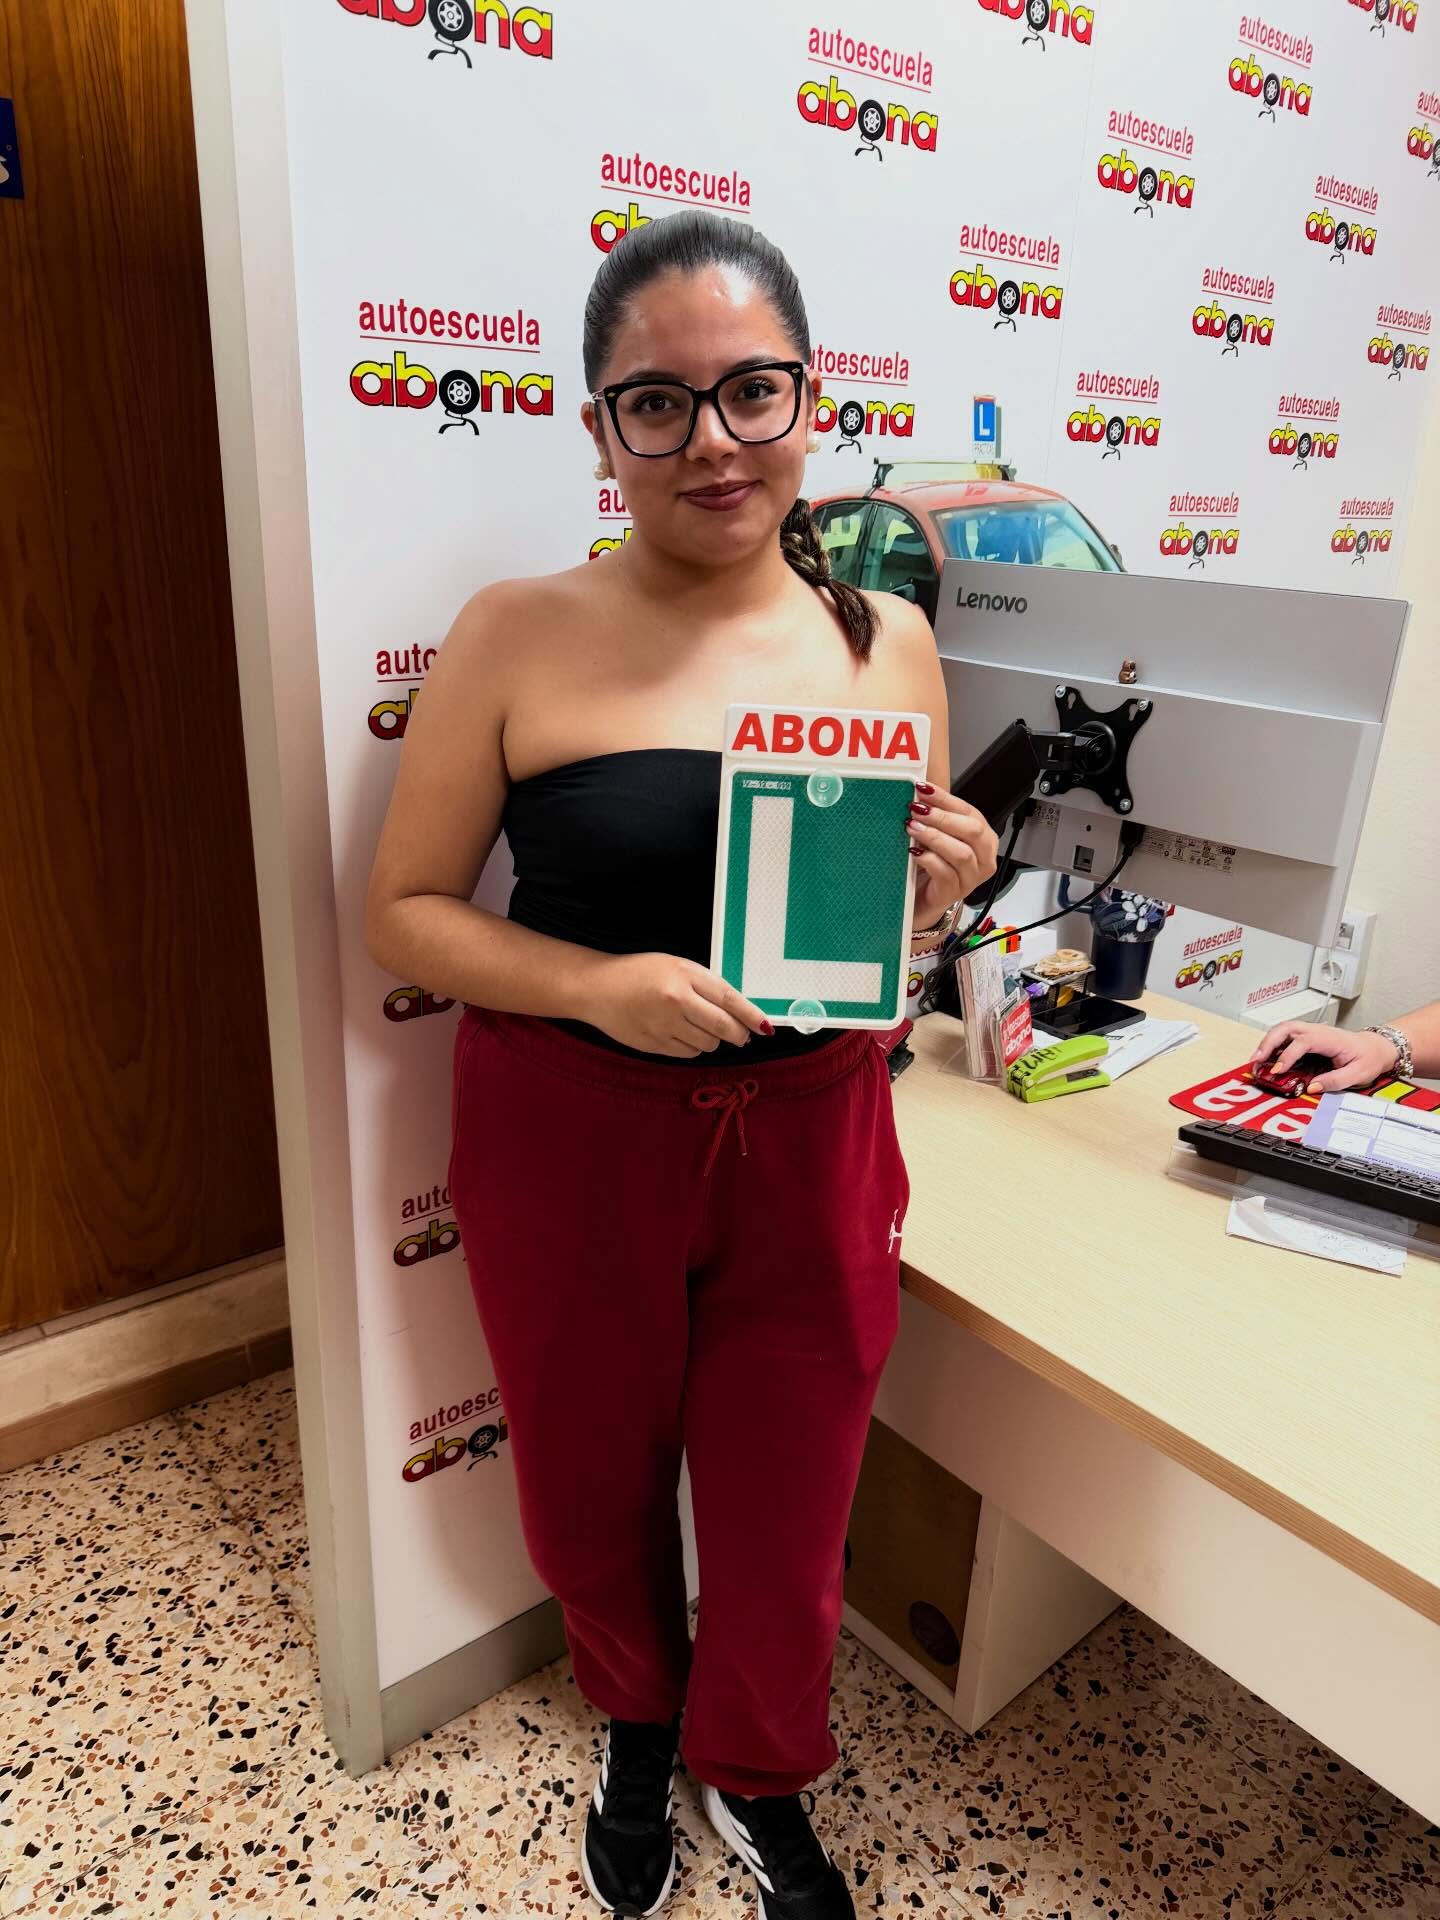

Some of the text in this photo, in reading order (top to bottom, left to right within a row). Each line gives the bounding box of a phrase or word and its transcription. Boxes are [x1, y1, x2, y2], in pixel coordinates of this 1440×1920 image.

[977, 0, 1095, 46] ona
[1240, 16, 1313, 63] autoescuela
[807, 27, 933, 88] autoescuela
[1228, 53, 1313, 117] abona
[797, 74, 939, 153] abona
[1107, 110, 1194, 155] autoescuela
[601, 152, 751, 207] autoescuela
[1097, 148, 1195, 209] abona
[1315, 173, 1379, 211] autoescuela
[960, 223, 1061, 265] autoescuela
[1305, 207, 1377, 257] abona
[949, 263, 1063, 320] abona
[1202, 266, 1275, 300] autoescuela
[359, 298, 541, 346] autoescuela
[1192, 300, 1275, 347] abona
[1377, 303, 1432, 332] autoescuela
[809, 344, 909, 380] toescuela
[1368, 332, 1430, 372] abona
[349, 350, 554, 417] abona
[1077, 369, 1159, 400] autoescuela
[979, 403, 991, 437] L
[1066, 404, 1162, 447] abona
[1278, 392, 1340, 419] autoescuela
[1268, 422, 1340, 460] abona
[1169, 491, 1239, 514] autoescuela
[1340, 496, 1394, 518] autoescuela
[1160, 521, 1241, 556] abona
[1331, 522, 1393, 553] abona
[956, 586, 1028, 614] Lenovo
[731, 713, 921, 761] ABONA
[741, 796, 884, 1004] L
[1184, 925, 1243, 957] autoescuela
[1175, 949, 1244, 988] abona
[1247, 974, 1300, 1005] autoescuela
[409, 1386, 500, 1441] autoesc
